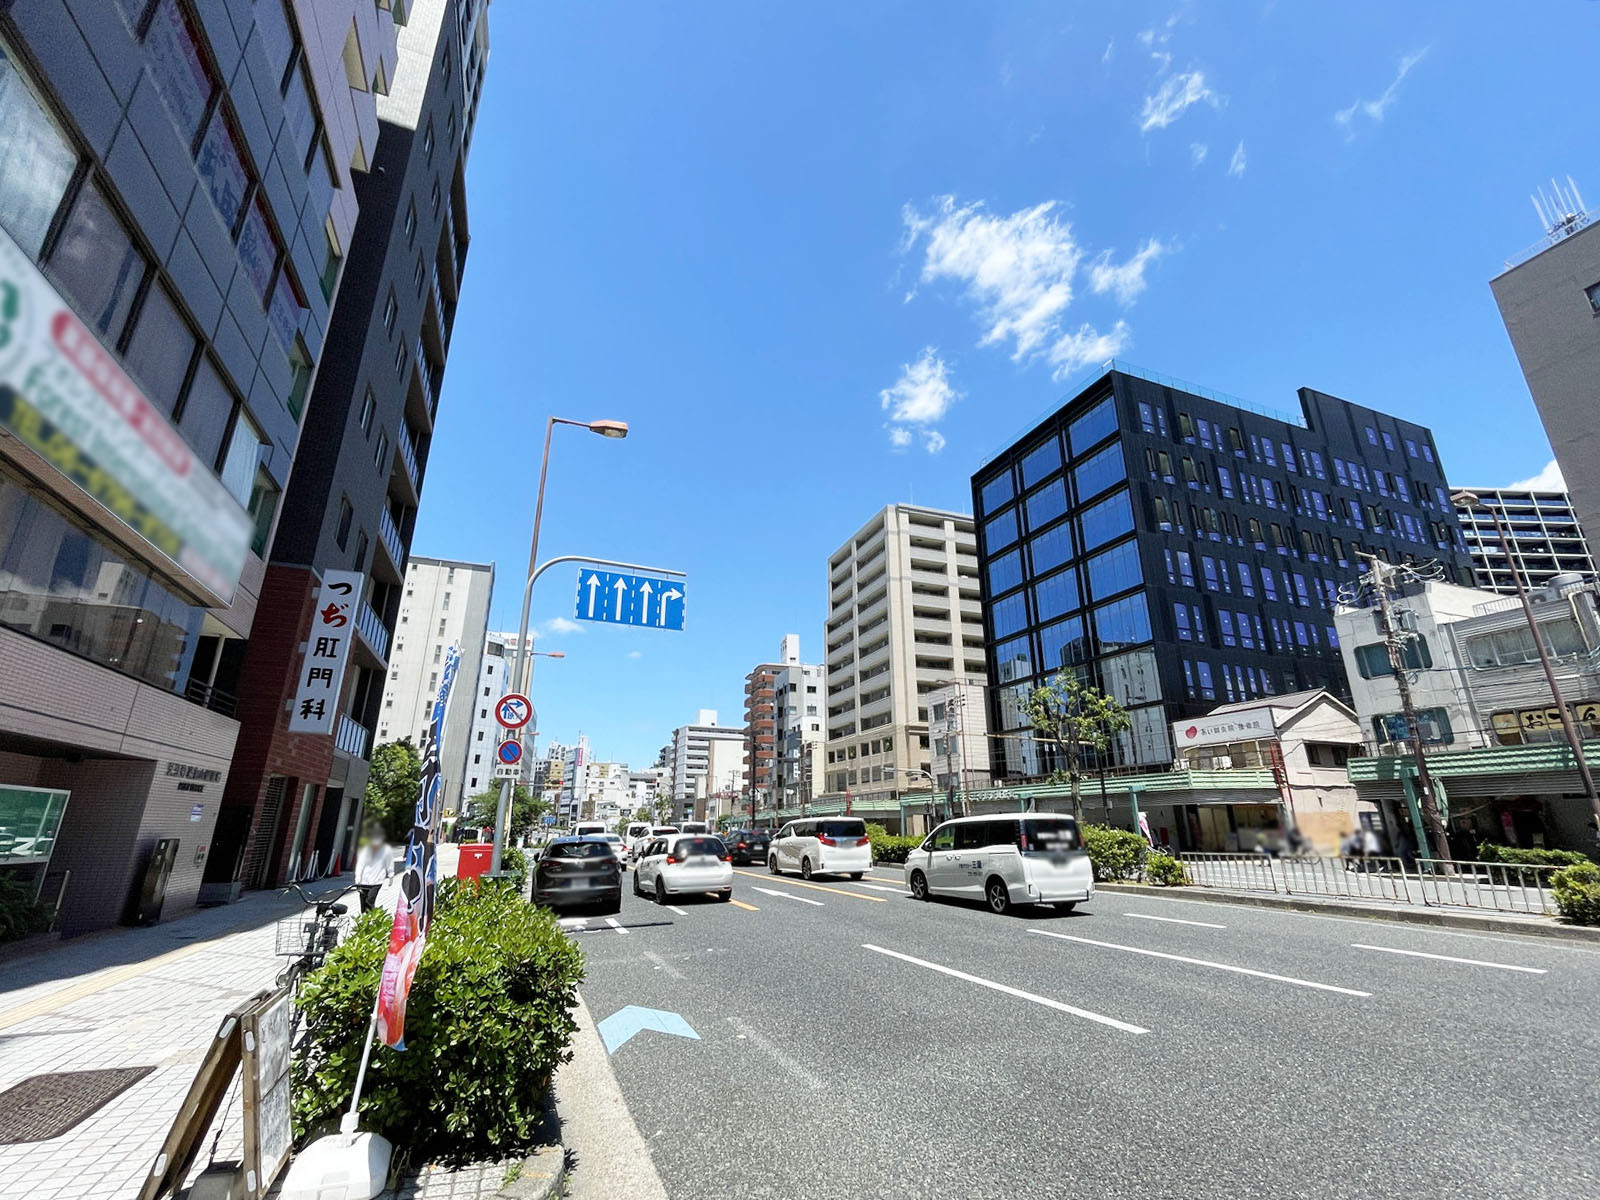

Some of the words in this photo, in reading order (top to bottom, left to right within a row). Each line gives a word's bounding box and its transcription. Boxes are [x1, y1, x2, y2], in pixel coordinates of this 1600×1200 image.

[299, 582, 353, 721] つぢ肛門科
